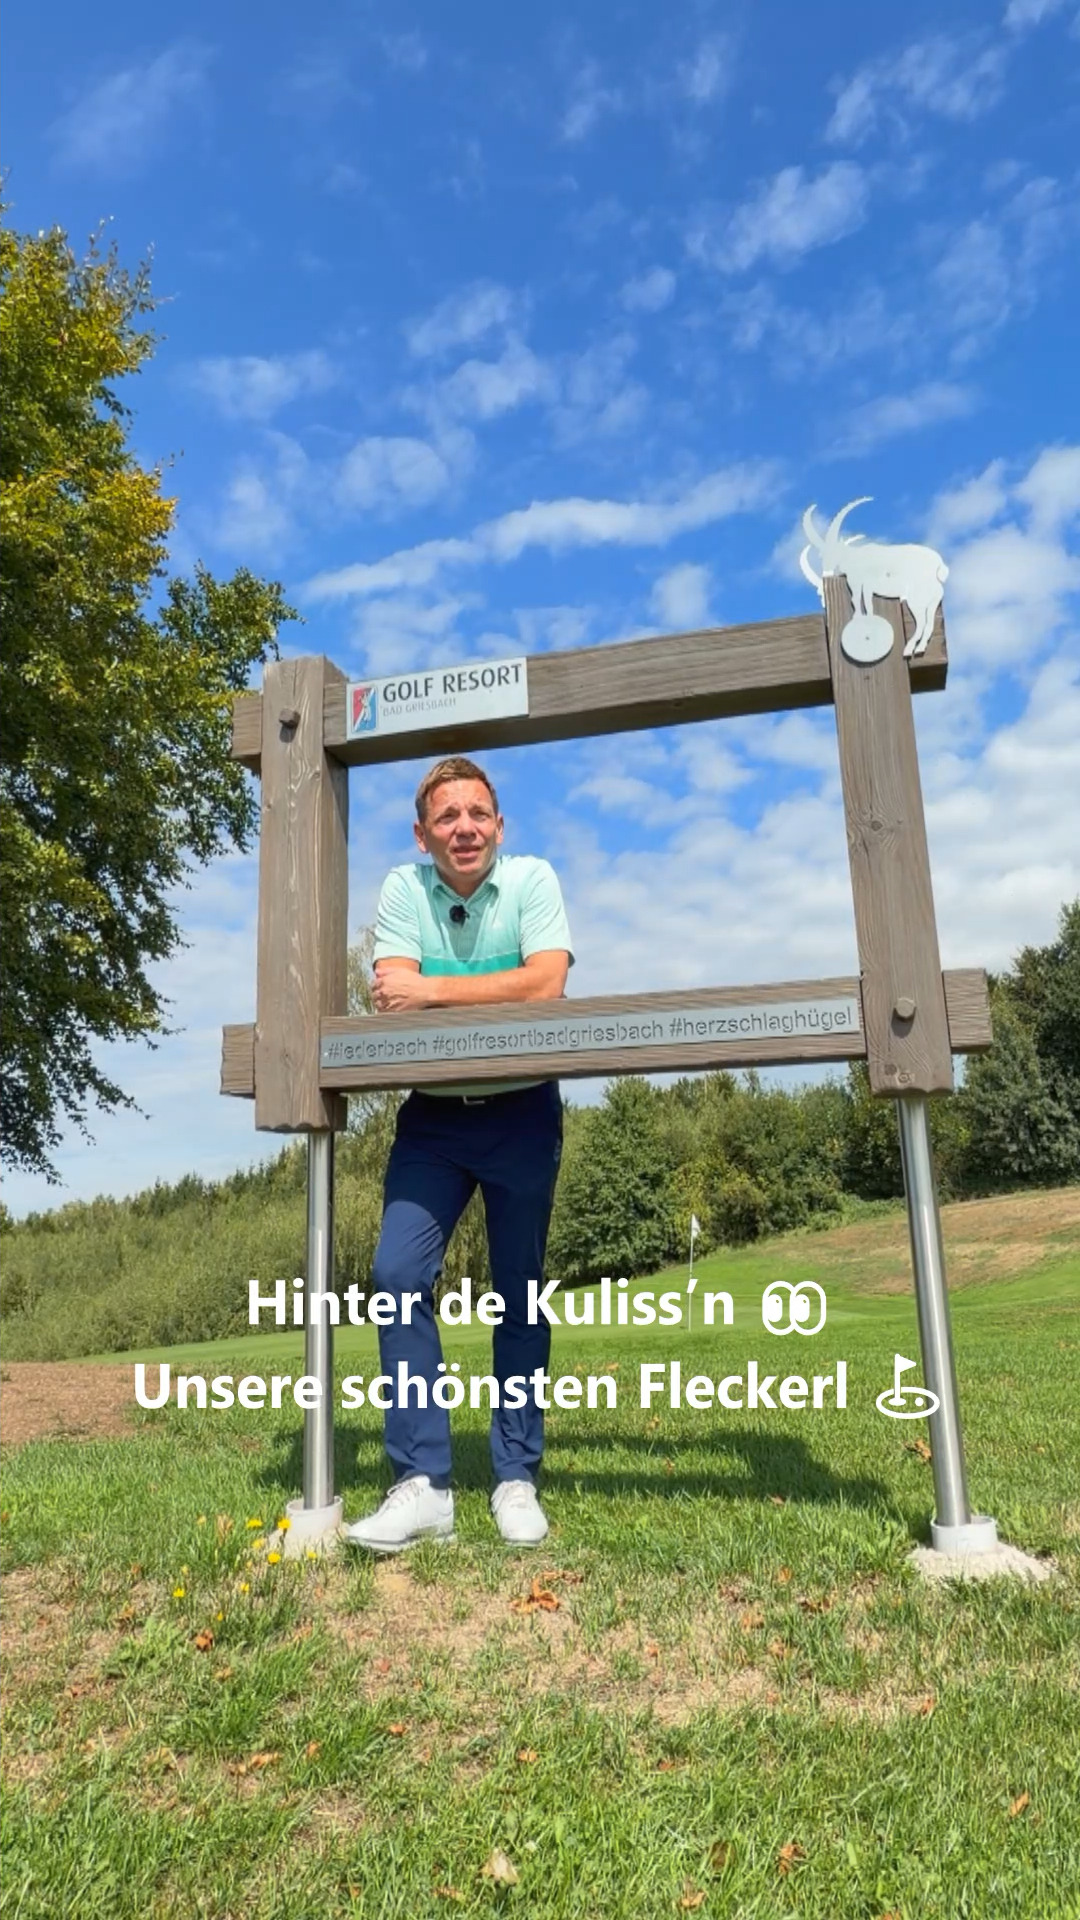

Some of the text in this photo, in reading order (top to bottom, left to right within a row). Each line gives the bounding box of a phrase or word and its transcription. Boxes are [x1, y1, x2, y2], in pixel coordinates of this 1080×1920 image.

[383, 663, 522, 702] GOLF RESORT
[382, 697, 457, 717] BAD GRIESBACH
[432, 1020, 663, 1057] #golfresortbadgriesbach
[669, 1006, 852, 1036] #herzschlaghügel
